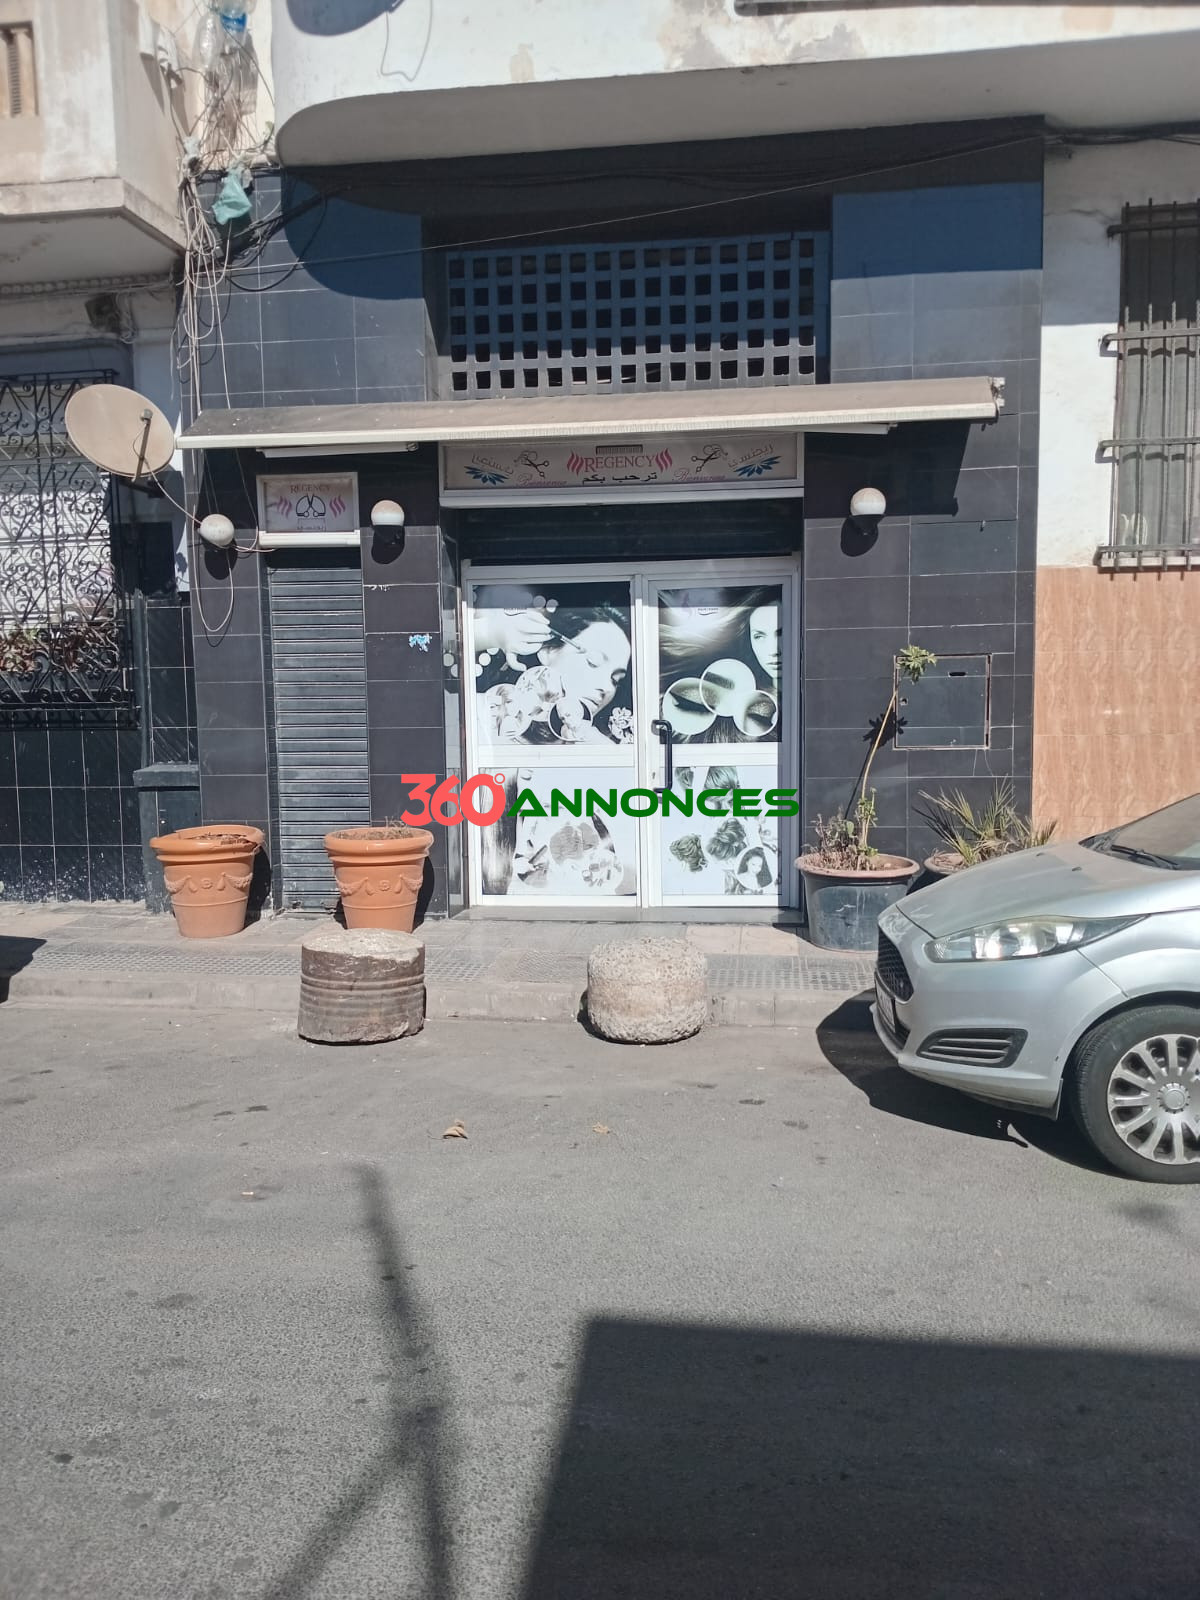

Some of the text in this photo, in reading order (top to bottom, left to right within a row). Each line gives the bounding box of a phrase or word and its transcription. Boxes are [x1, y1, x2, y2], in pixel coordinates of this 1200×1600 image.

[583, 455, 656, 473] REGENCY
[582, 472, 657, 485] ترحب بكم
